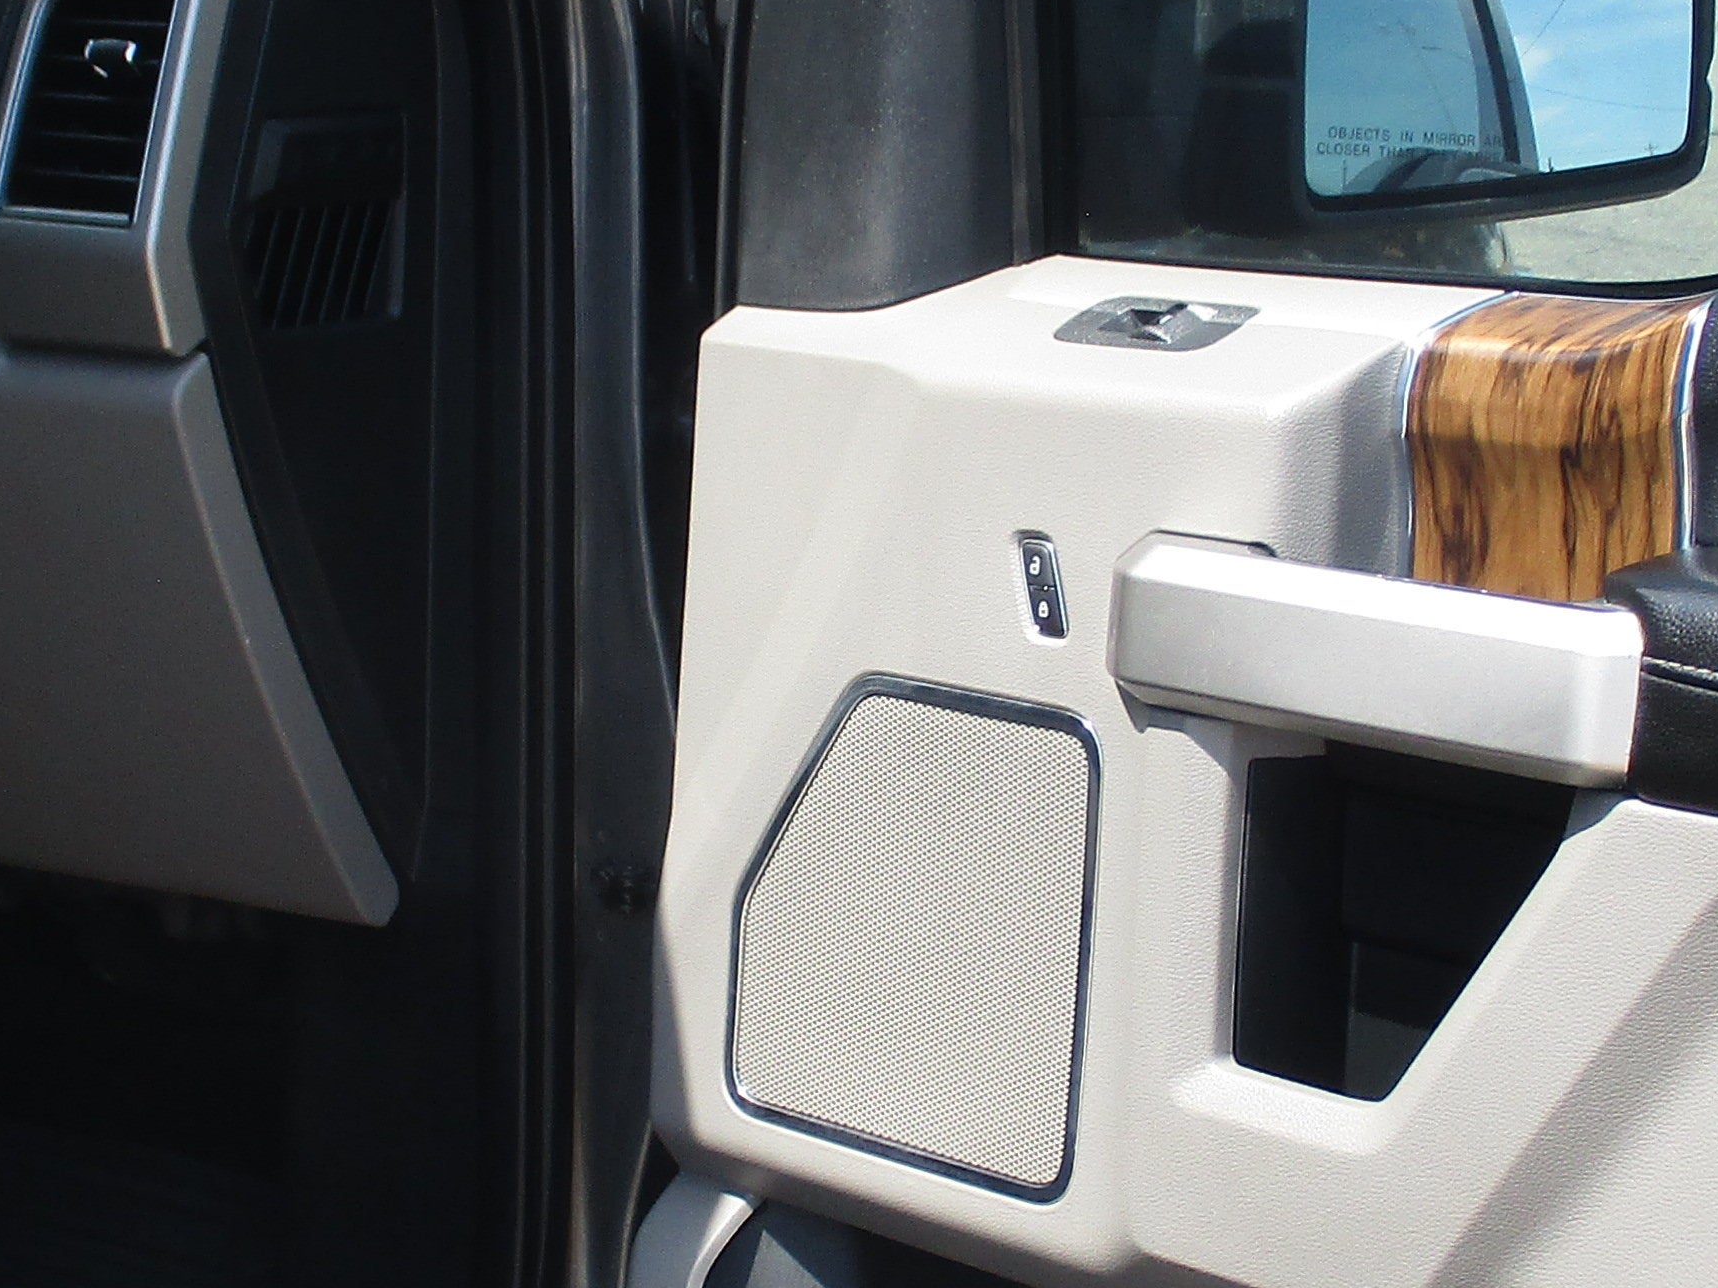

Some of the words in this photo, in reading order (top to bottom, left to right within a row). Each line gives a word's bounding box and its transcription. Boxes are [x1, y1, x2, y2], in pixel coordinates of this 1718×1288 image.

[1327, 126, 1390, 141] OBJECTS
[1400, 128, 1414, 143] IN
[1424, 131, 1475, 146] MIRROR
[1316, 142, 1370, 157] CLOSER
